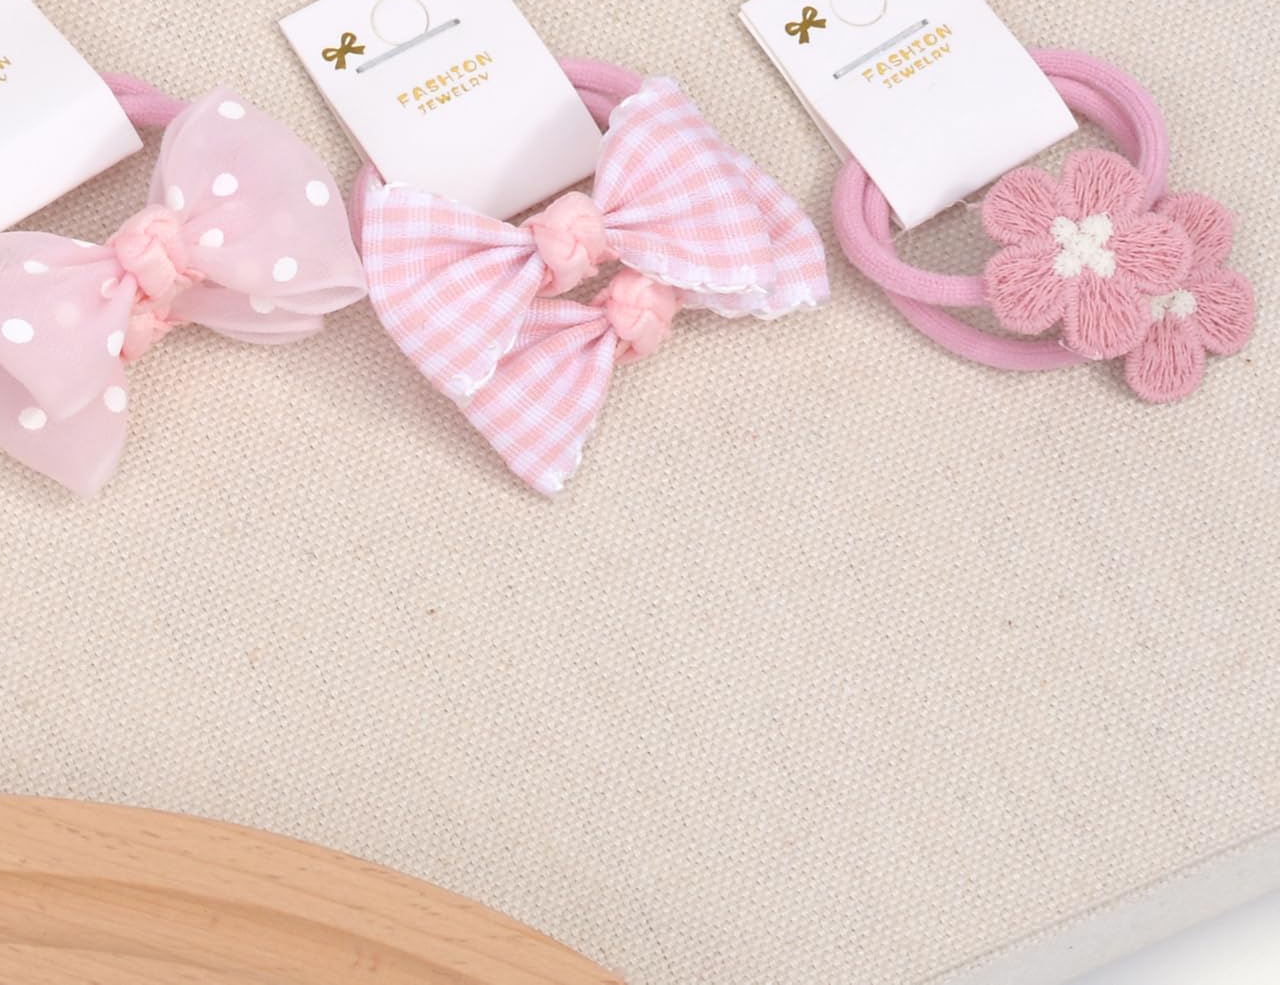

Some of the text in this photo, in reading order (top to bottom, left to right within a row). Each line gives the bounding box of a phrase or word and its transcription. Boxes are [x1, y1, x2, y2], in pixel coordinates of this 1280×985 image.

[862, 23, 952, 83] FASHION
[882, 42, 951, 89] JEWELRY
[397, 51, 492, 109] FASHION
[417, 71, 489, 115] JEWELRY
